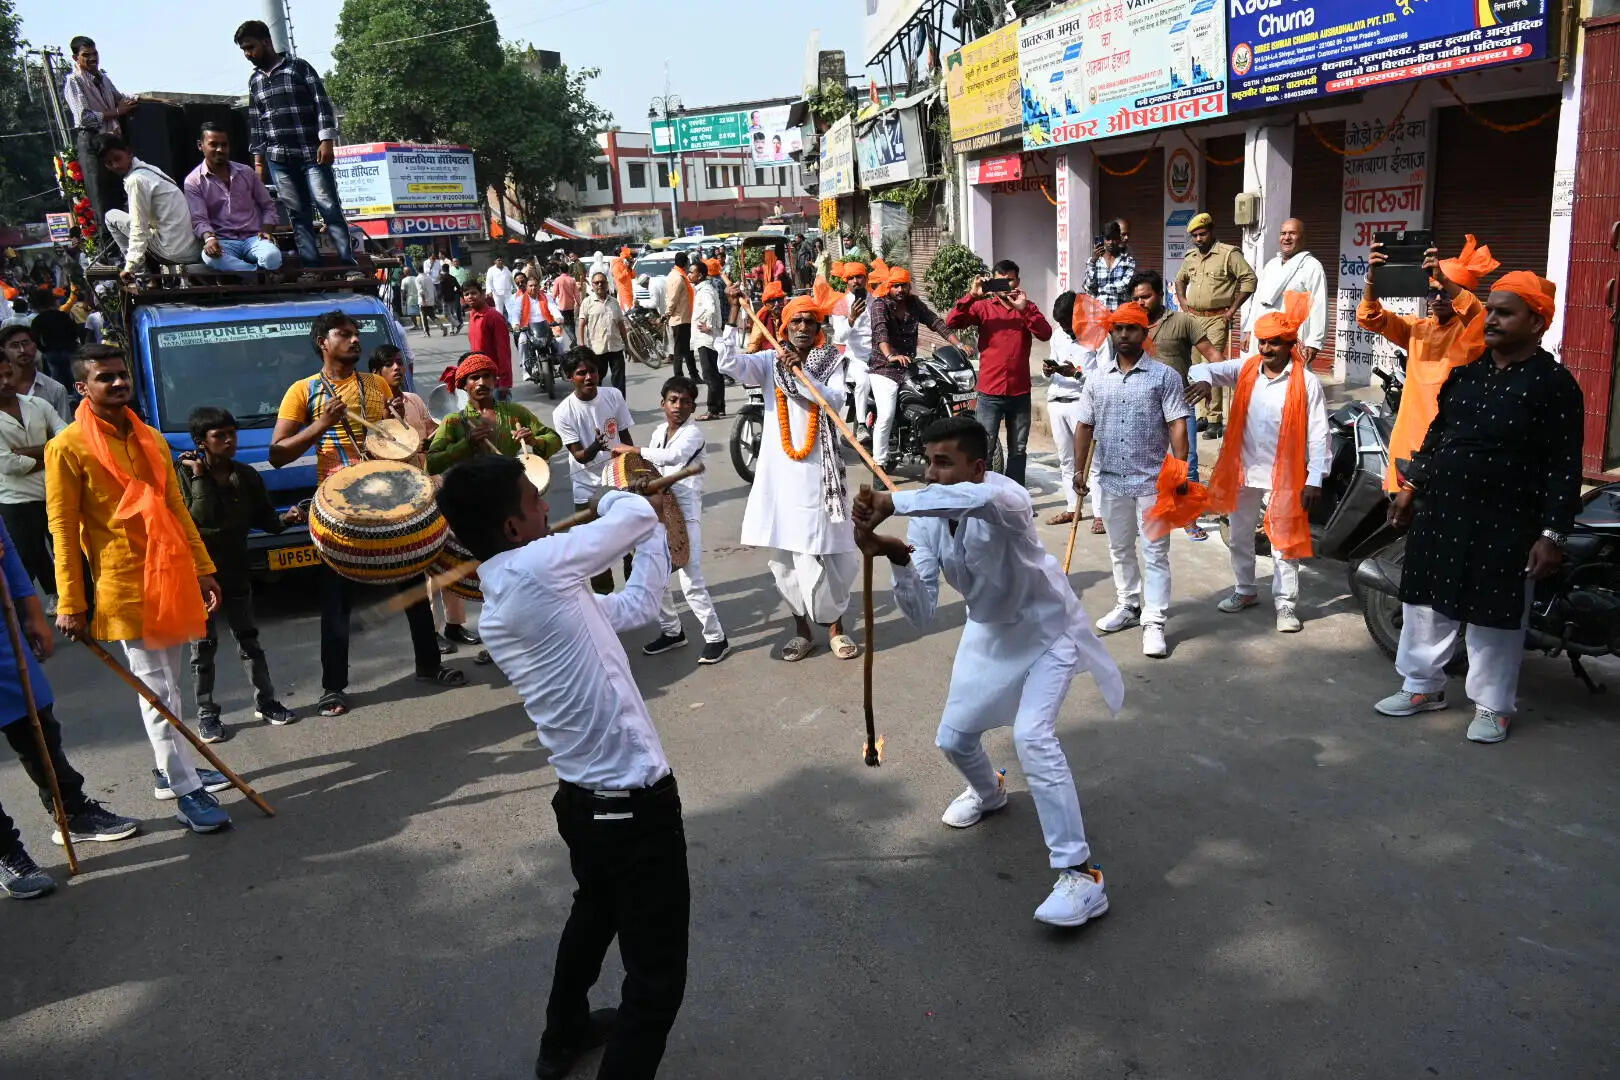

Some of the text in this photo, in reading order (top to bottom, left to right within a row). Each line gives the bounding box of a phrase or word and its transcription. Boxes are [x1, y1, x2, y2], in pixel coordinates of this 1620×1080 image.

[1258, 8, 1315, 38] Churna
[1367, 16, 1382, 27] PVT.
[1382, 13, 1397, 24] LTD.
[1366, 64, 1379, 75] का
[1243, 79, 1260, 88] GSTIN
[1052, 119, 1098, 143] शंकर
[1106, 92, 1225, 134] औषधालय
[689, 126, 713, 134] AIRPORT
[702, 140, 720, 148] STAND
[404, 216, 467, 232] POLICE
[1340, 254, 1369, 276] टैबले
[203, 325, 264, 338] PUNEET
